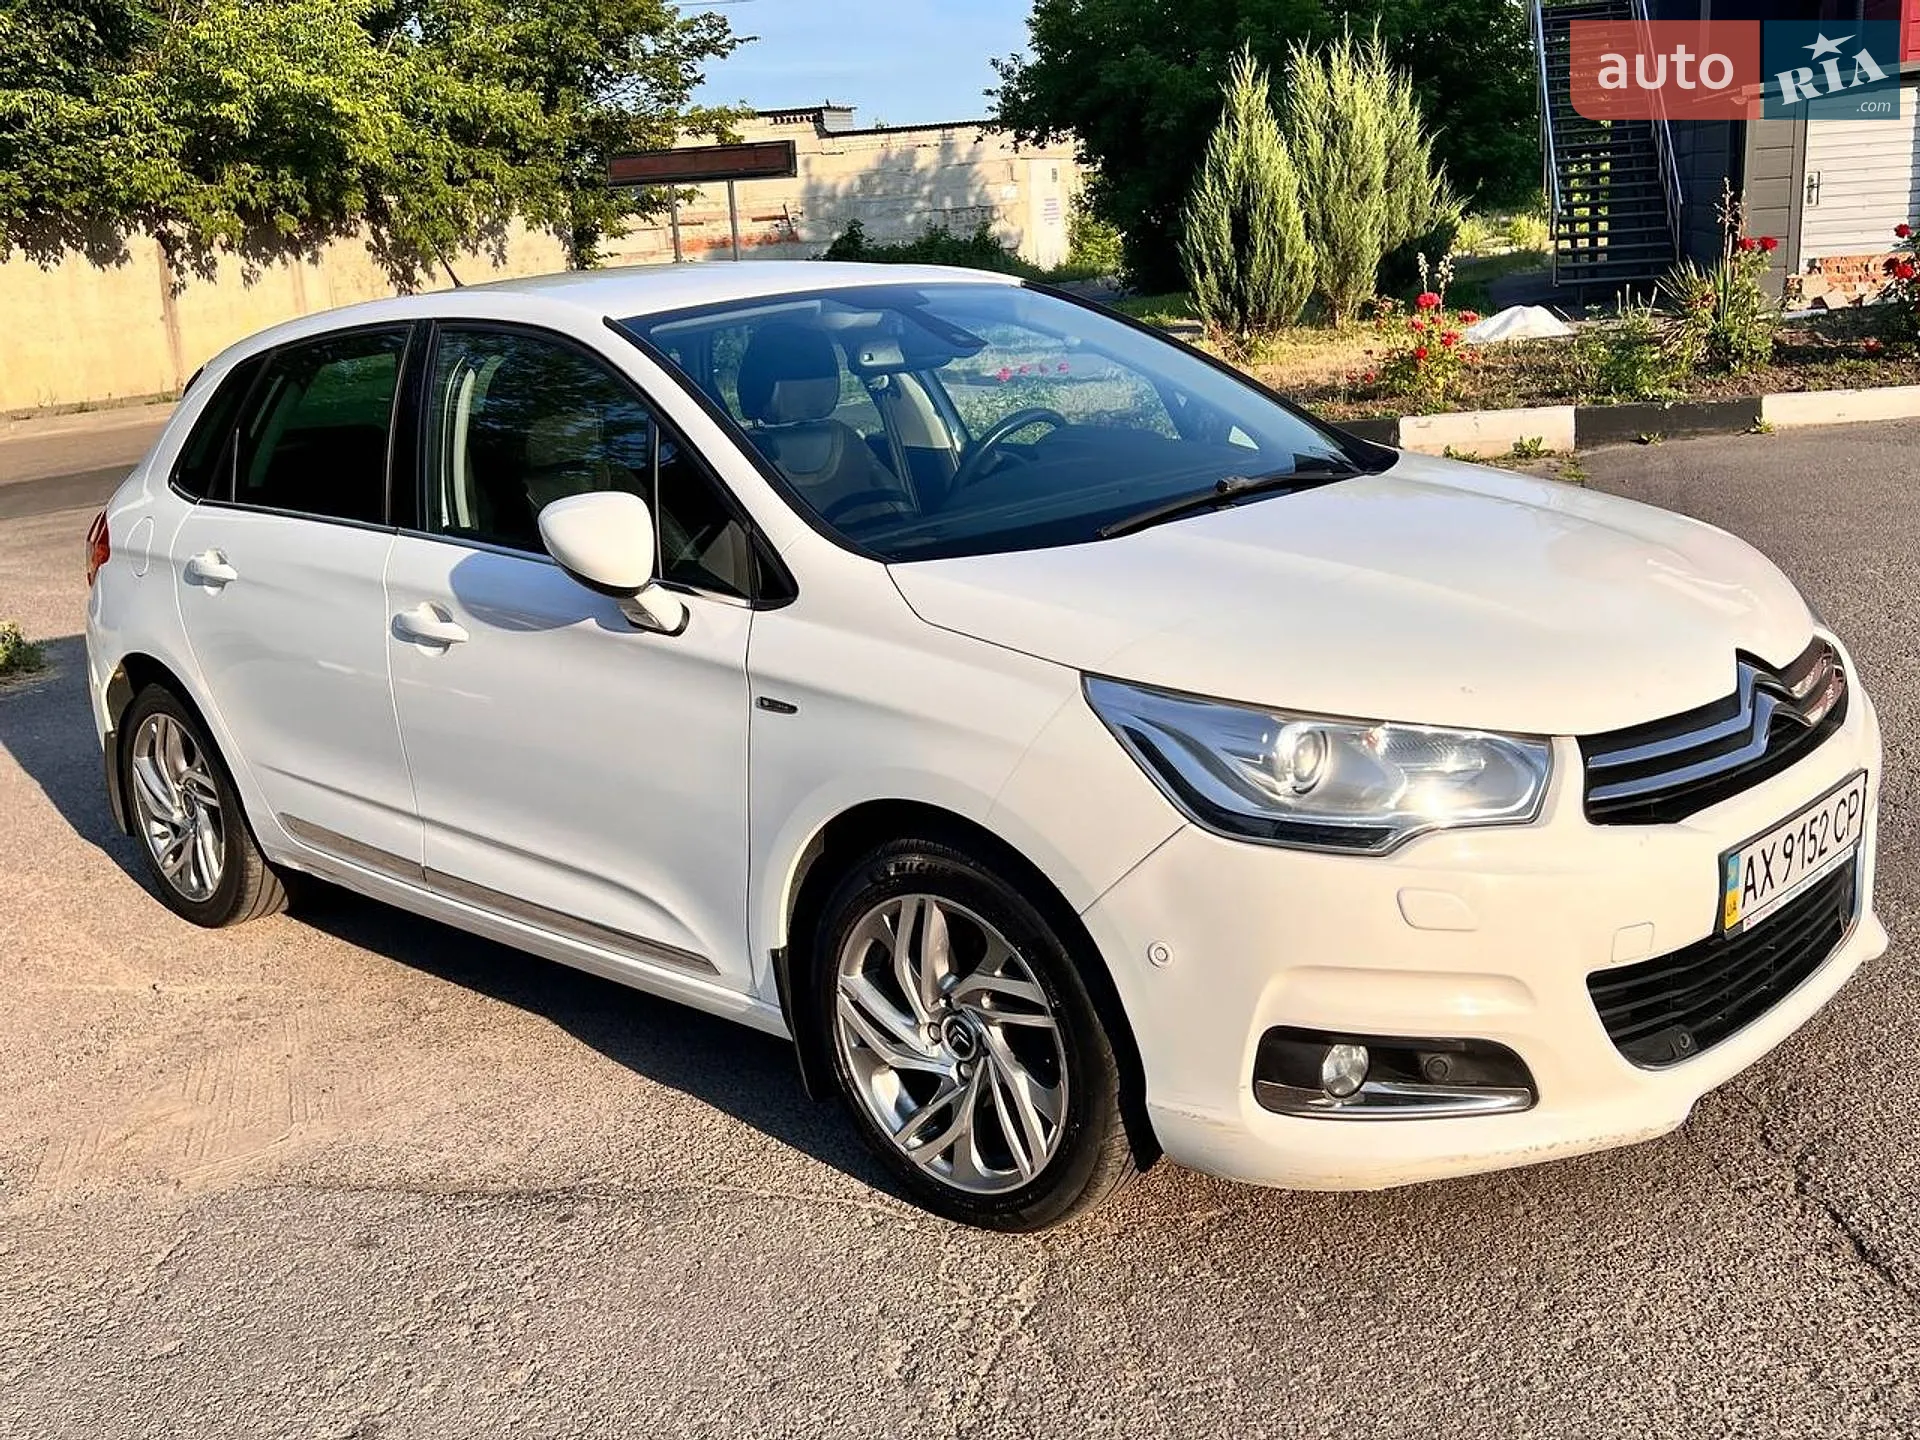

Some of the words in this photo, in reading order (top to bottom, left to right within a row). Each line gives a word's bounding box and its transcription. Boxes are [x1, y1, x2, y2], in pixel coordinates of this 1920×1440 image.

[1742, 842, 1776, 909] AX
[1783, 810, 1829, 883] 9152
[1834, 789, 1860, 843] CP
